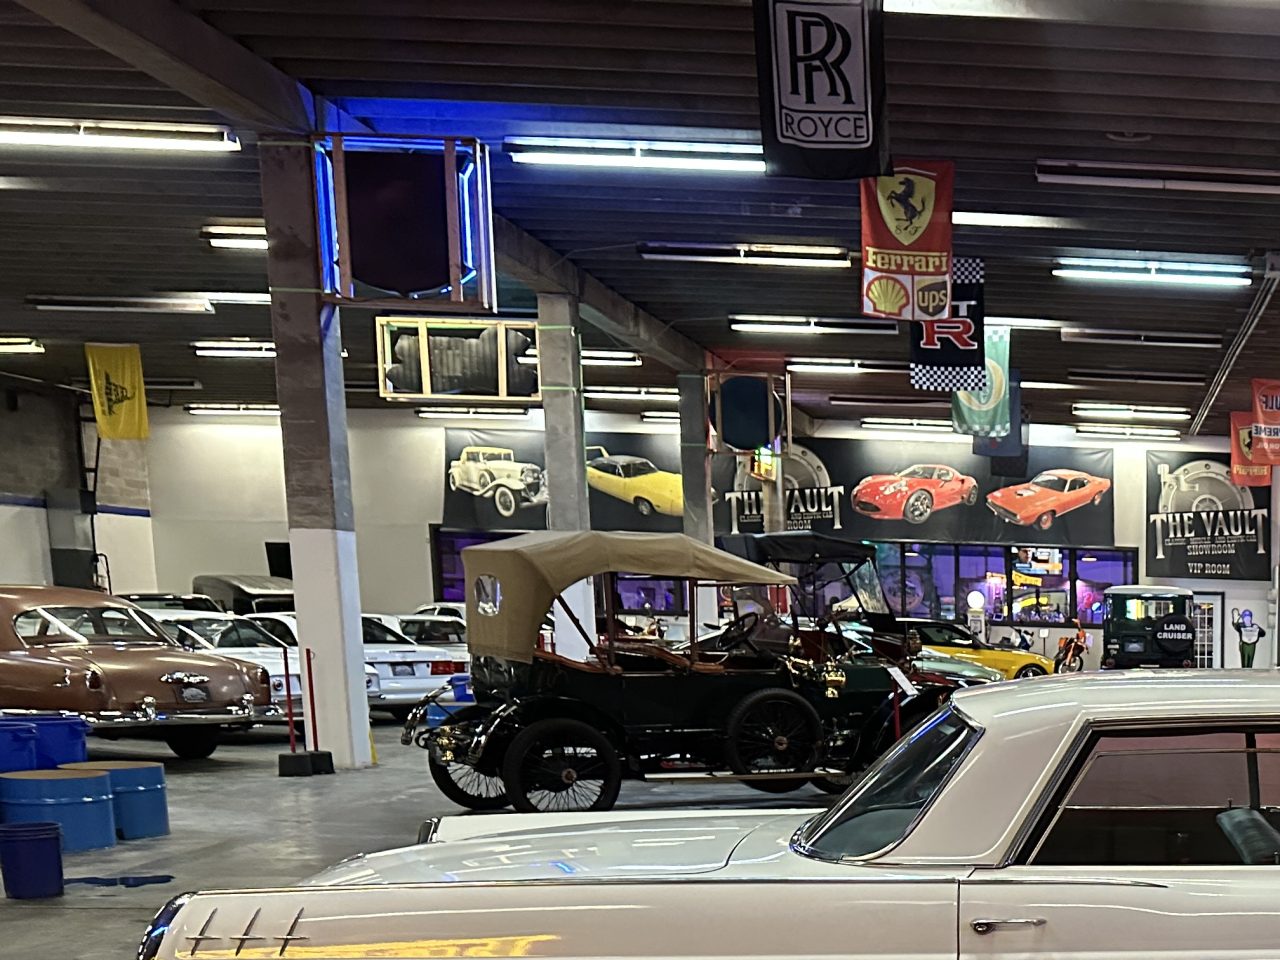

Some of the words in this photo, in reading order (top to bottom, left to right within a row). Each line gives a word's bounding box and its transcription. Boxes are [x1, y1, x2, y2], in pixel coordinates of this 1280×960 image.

[783, 112, 866, 139] ROYCE
[865, 246, 948, 272] Ferrari
[917, 290, 948, 313] ups
[951, 300, 978, 316] T
[920, 317, 979, 350] R
[724, 490, 763, 535] TH
[1149, 511, 1195, 559] THE
[1200, 508, 1268, 554] VAULT
[1186, 543, 1236, 555] SHOWROOM
[1187, 562, 1203, 574] VIP
[1205, 563, 1231, 575] ROOM
[1156, 632, 1193, 640] CRUISER
[1163, 623, 1187, 631] LAND
